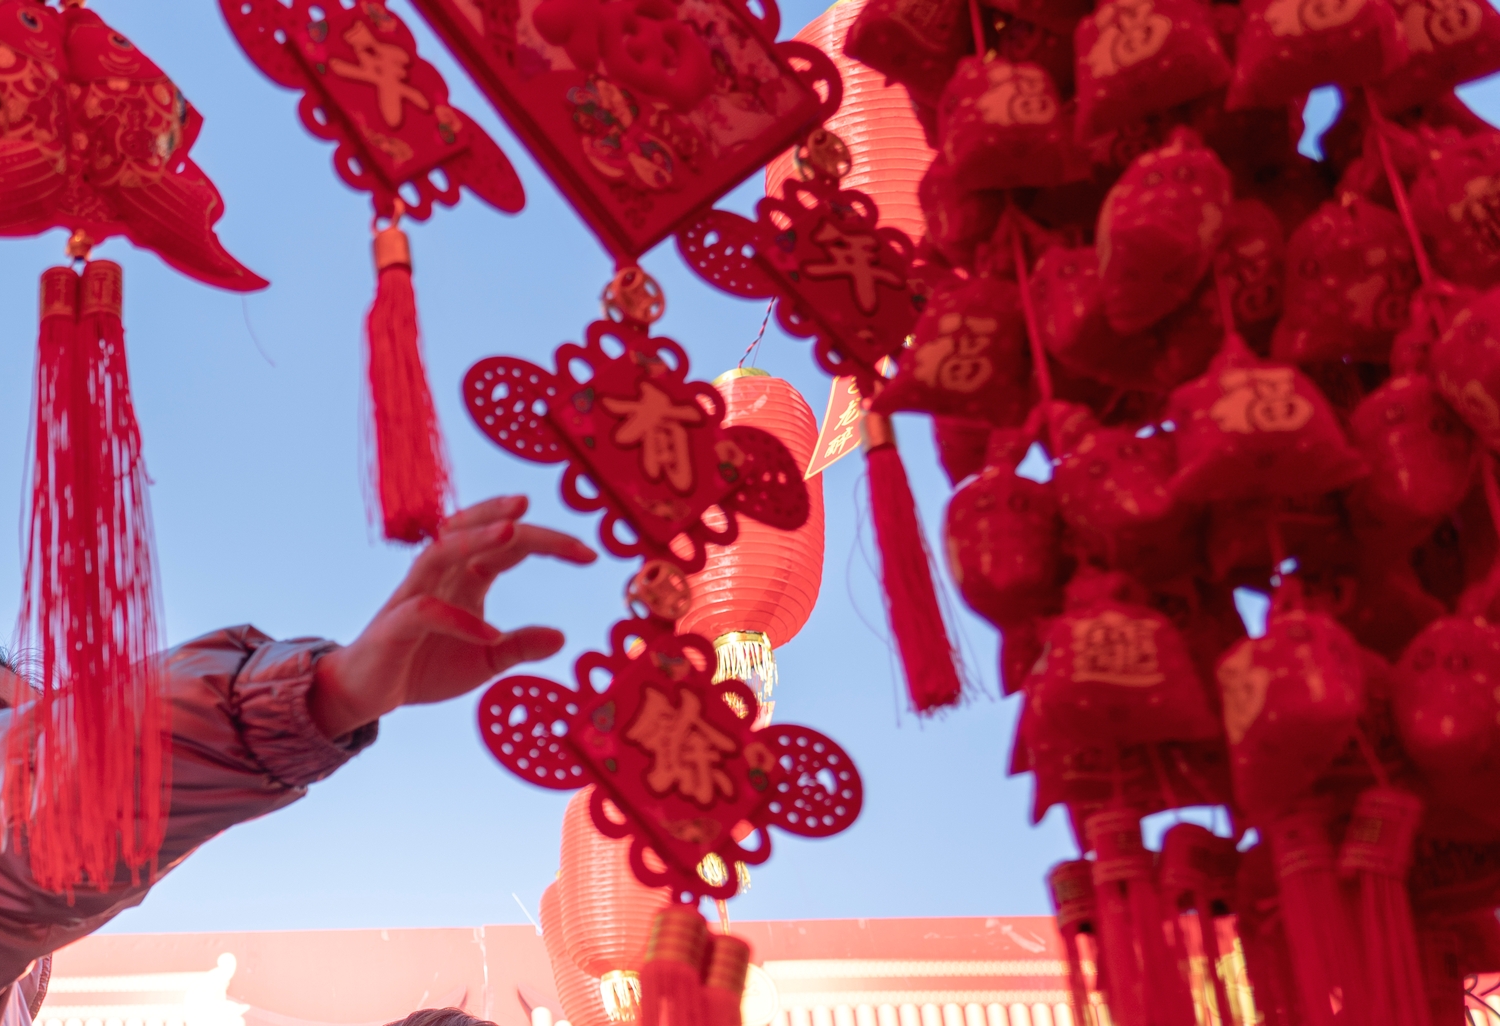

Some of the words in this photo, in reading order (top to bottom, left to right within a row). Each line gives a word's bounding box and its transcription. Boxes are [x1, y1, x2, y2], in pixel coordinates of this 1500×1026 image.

[806, 222, 903, 309] 年
[914, 313, 996, 392] 福
[602, 381, 703, 492] 有
[1210, 368, 1313, 434] 福
